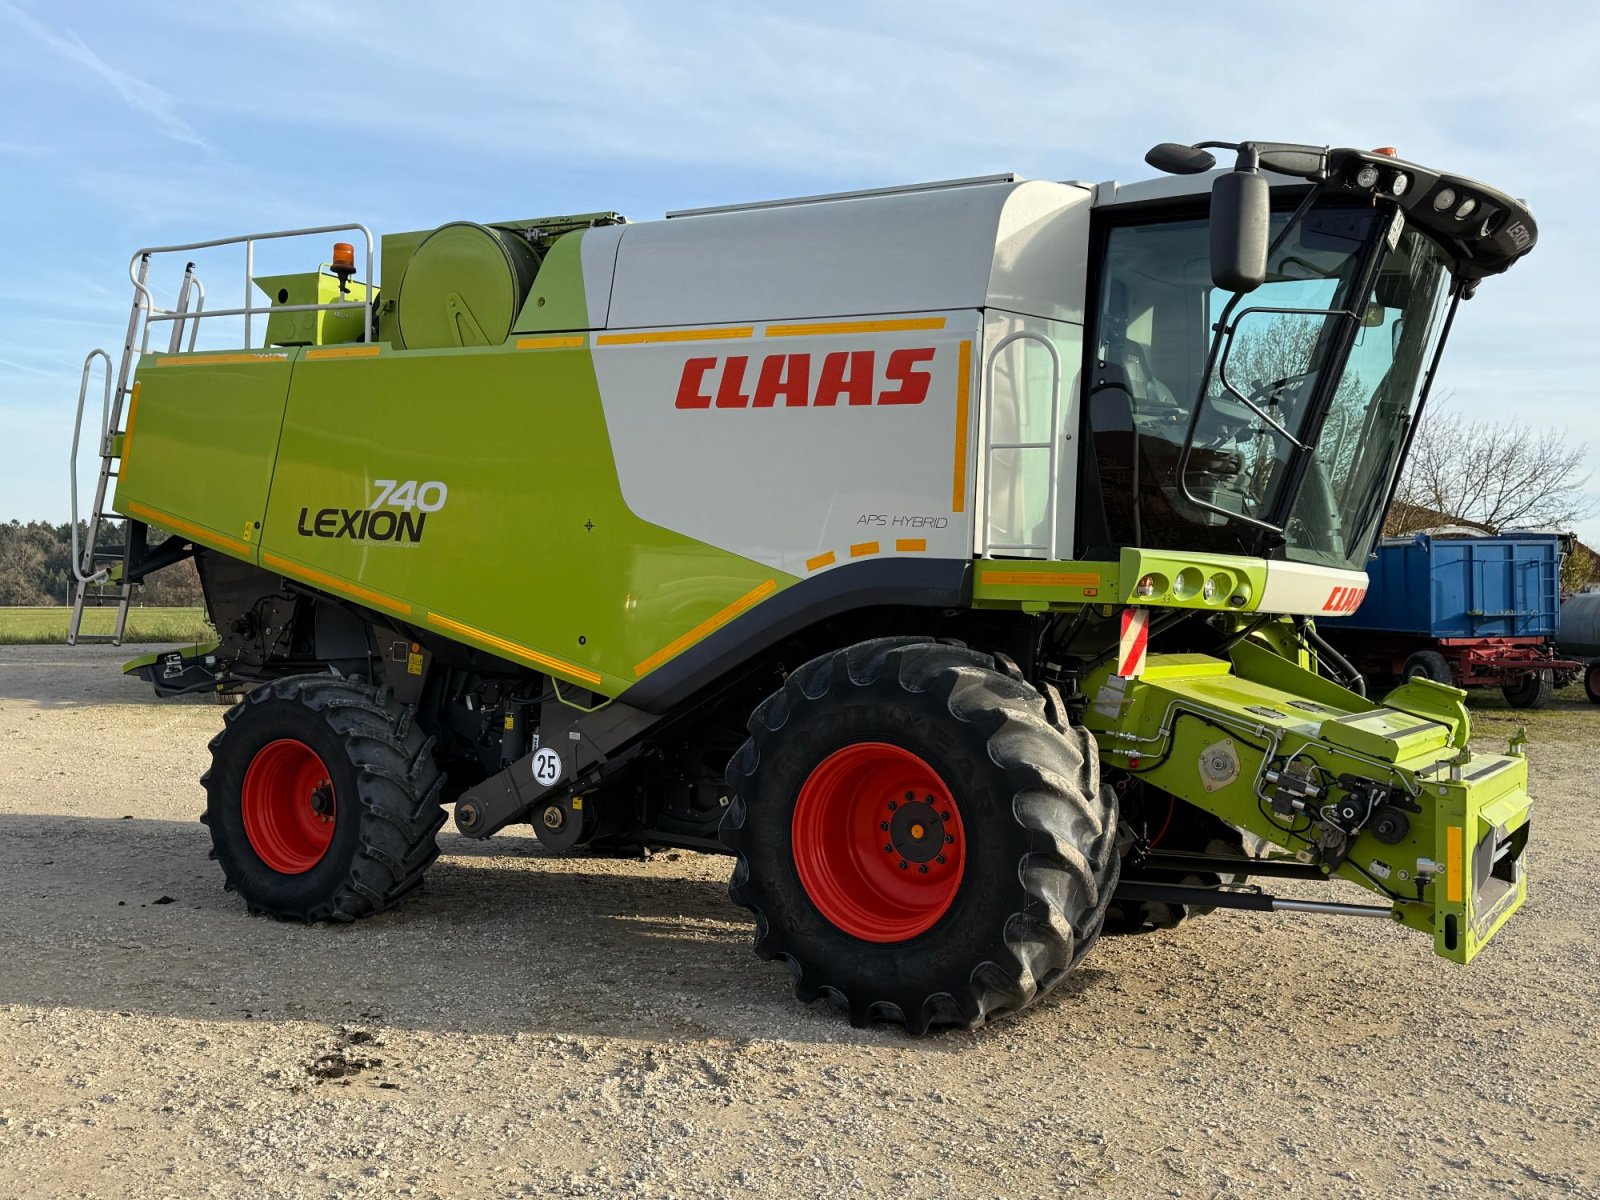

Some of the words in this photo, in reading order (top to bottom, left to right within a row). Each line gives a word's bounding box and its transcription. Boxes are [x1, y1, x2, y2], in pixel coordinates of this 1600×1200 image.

[675, 347, 936, 409] CLAAS
[369, 479, 448, 512] 740
[297, 507, 427, 542] LEXION
[856, 514, 888, 526] APS
[892, 515, 948, 529] HYBRID
[1322, 586, 1367, 612] CLAA
[537, 754, 556, 779] 25
